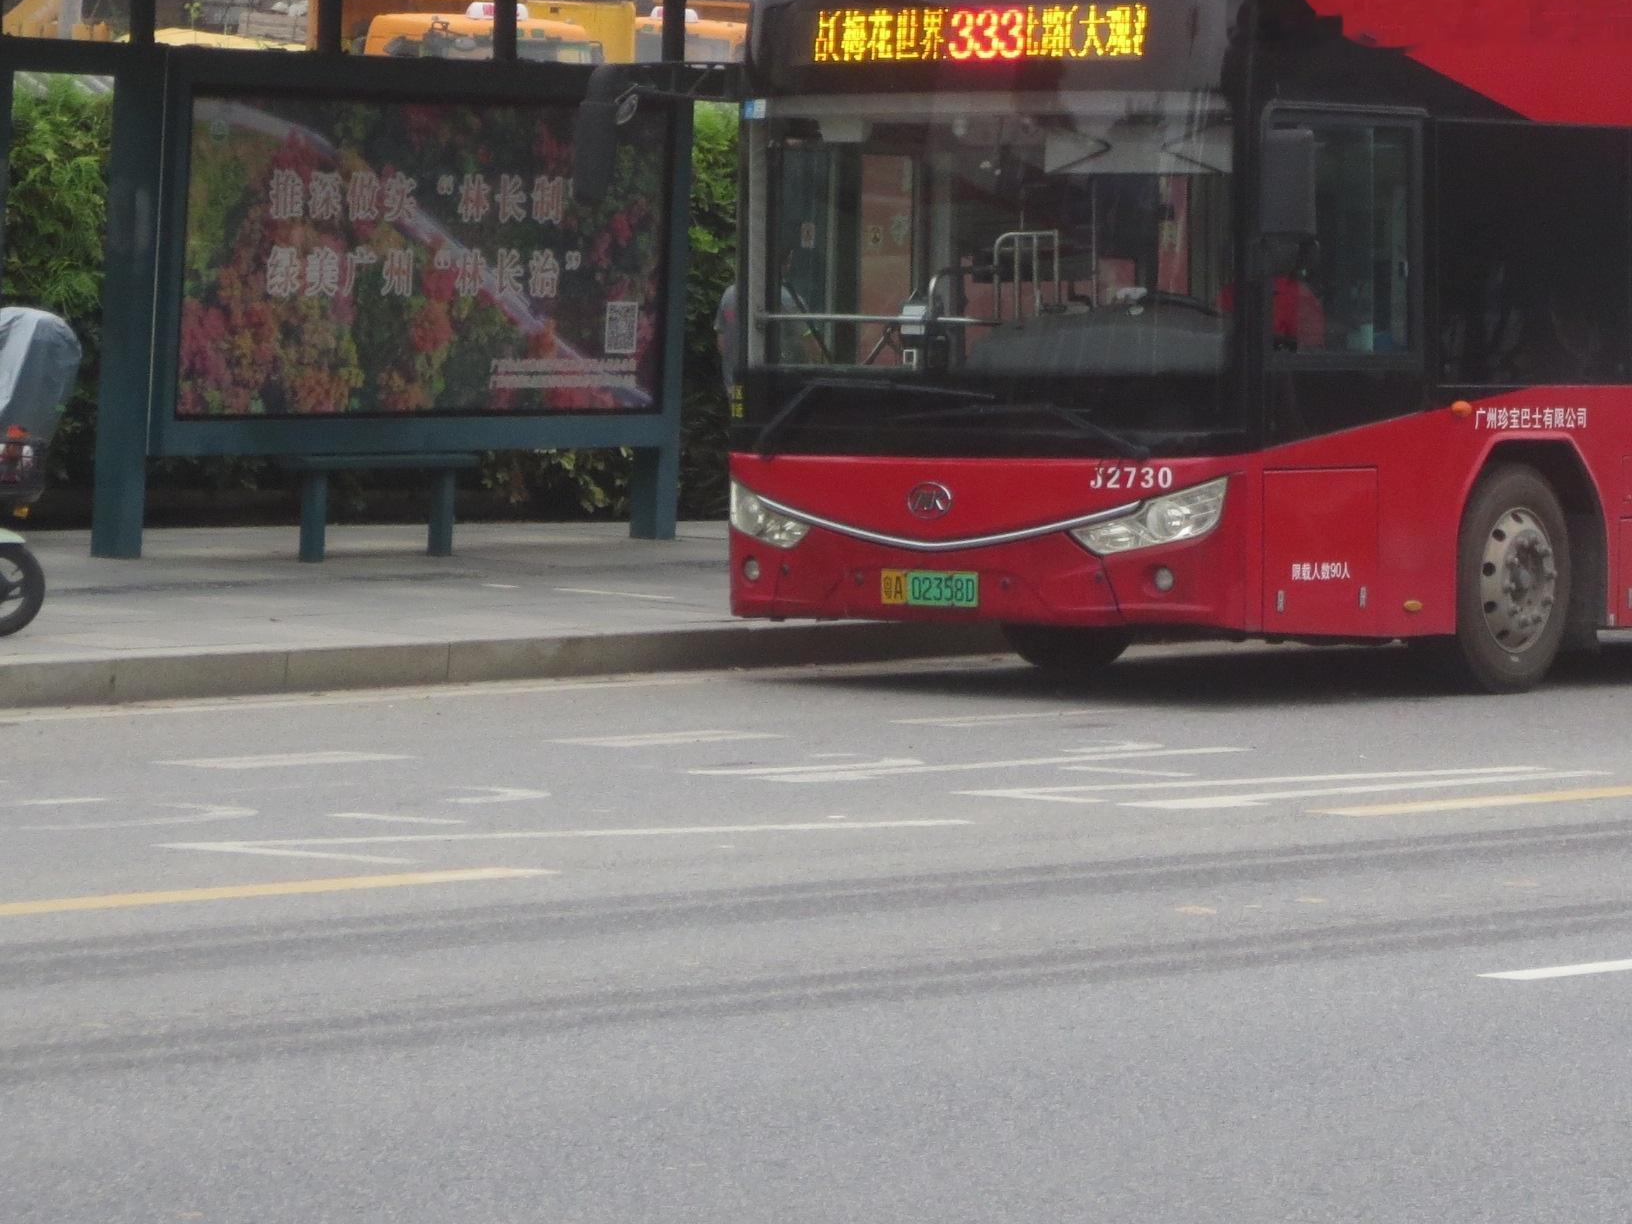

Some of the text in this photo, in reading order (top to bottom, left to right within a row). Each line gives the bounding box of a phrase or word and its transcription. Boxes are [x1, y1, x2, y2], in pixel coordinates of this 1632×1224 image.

[947, 9, 1024, 60] 333
[1474, 406, 1588, 431] 广州珍宝巴士有限公司
[1090, 466, 1173, 489] J2730
